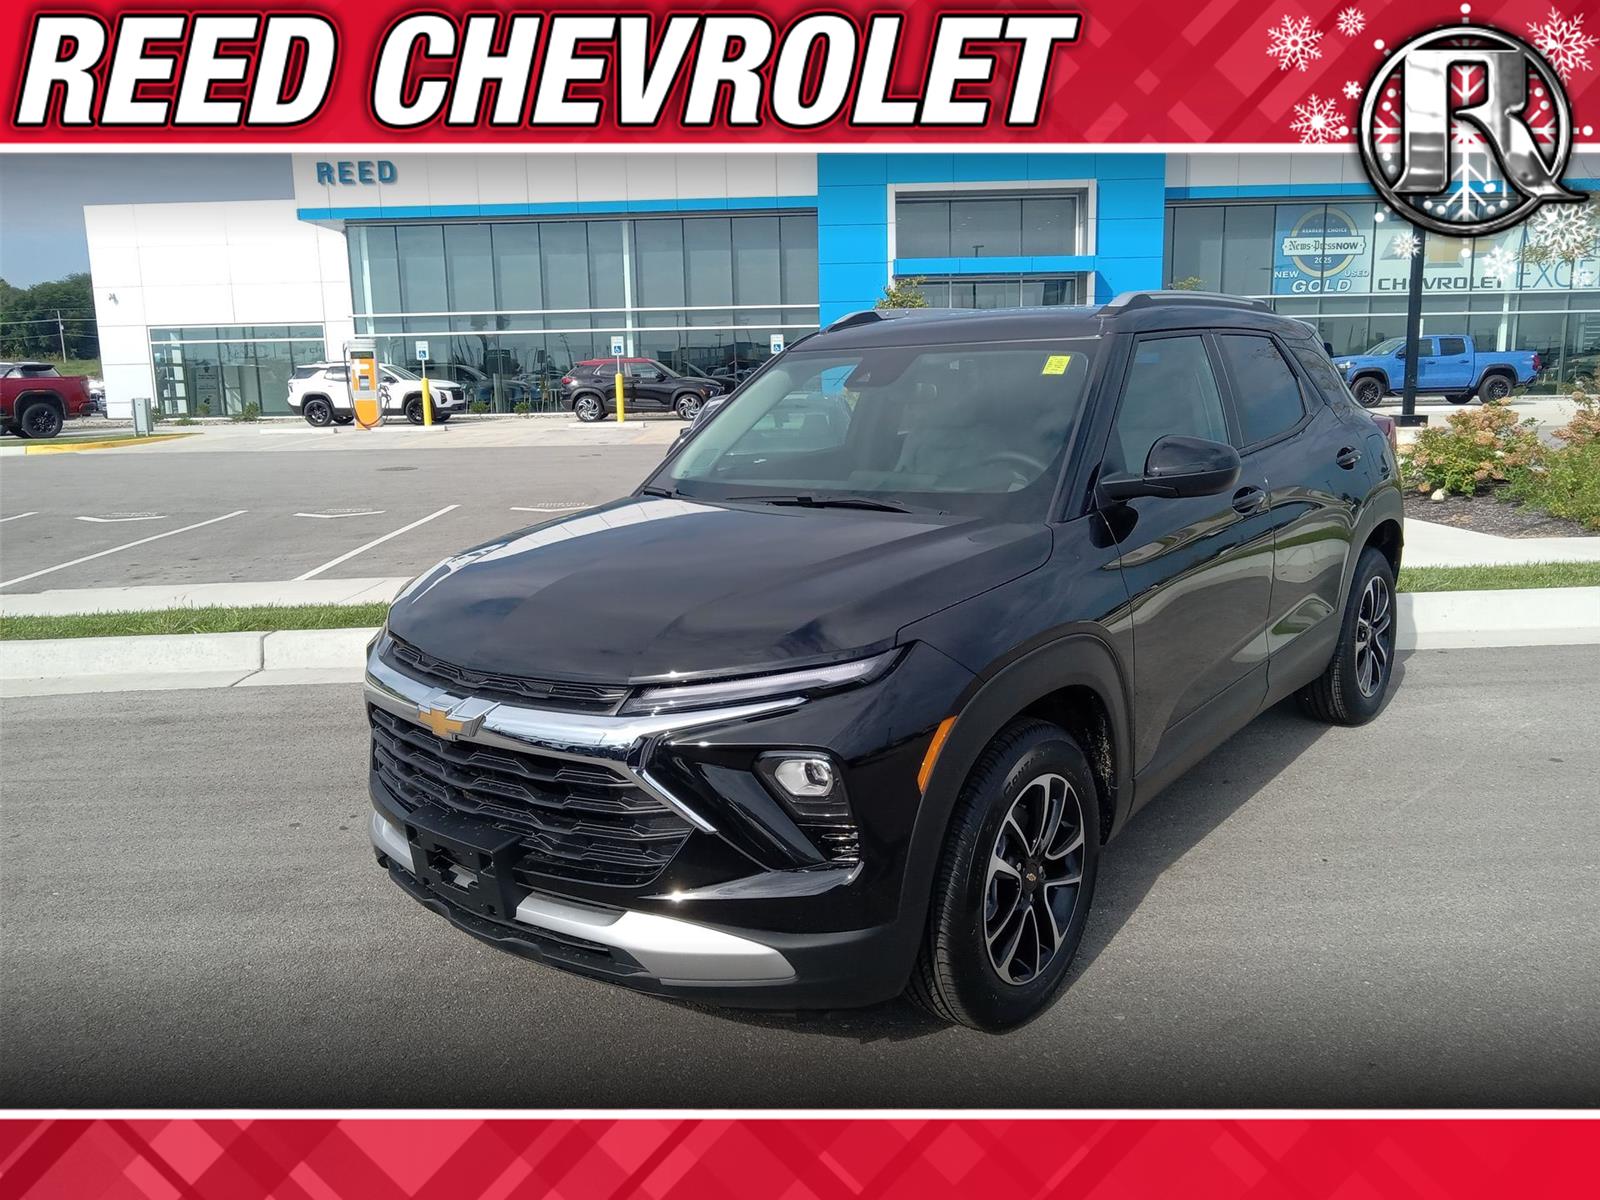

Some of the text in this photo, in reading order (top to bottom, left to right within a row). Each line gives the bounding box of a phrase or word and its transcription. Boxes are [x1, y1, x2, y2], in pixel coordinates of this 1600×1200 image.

[316, 160, 398, 186] REED
[1275, 270, 1299, 279] NEW
[1344, 270, 1370, 278] USED
[1515, 258, 1600, 289] EXCE
[1291, 279, 1353, 294] GOLD
[1377, 276, 1502, 291] CHVROLET
